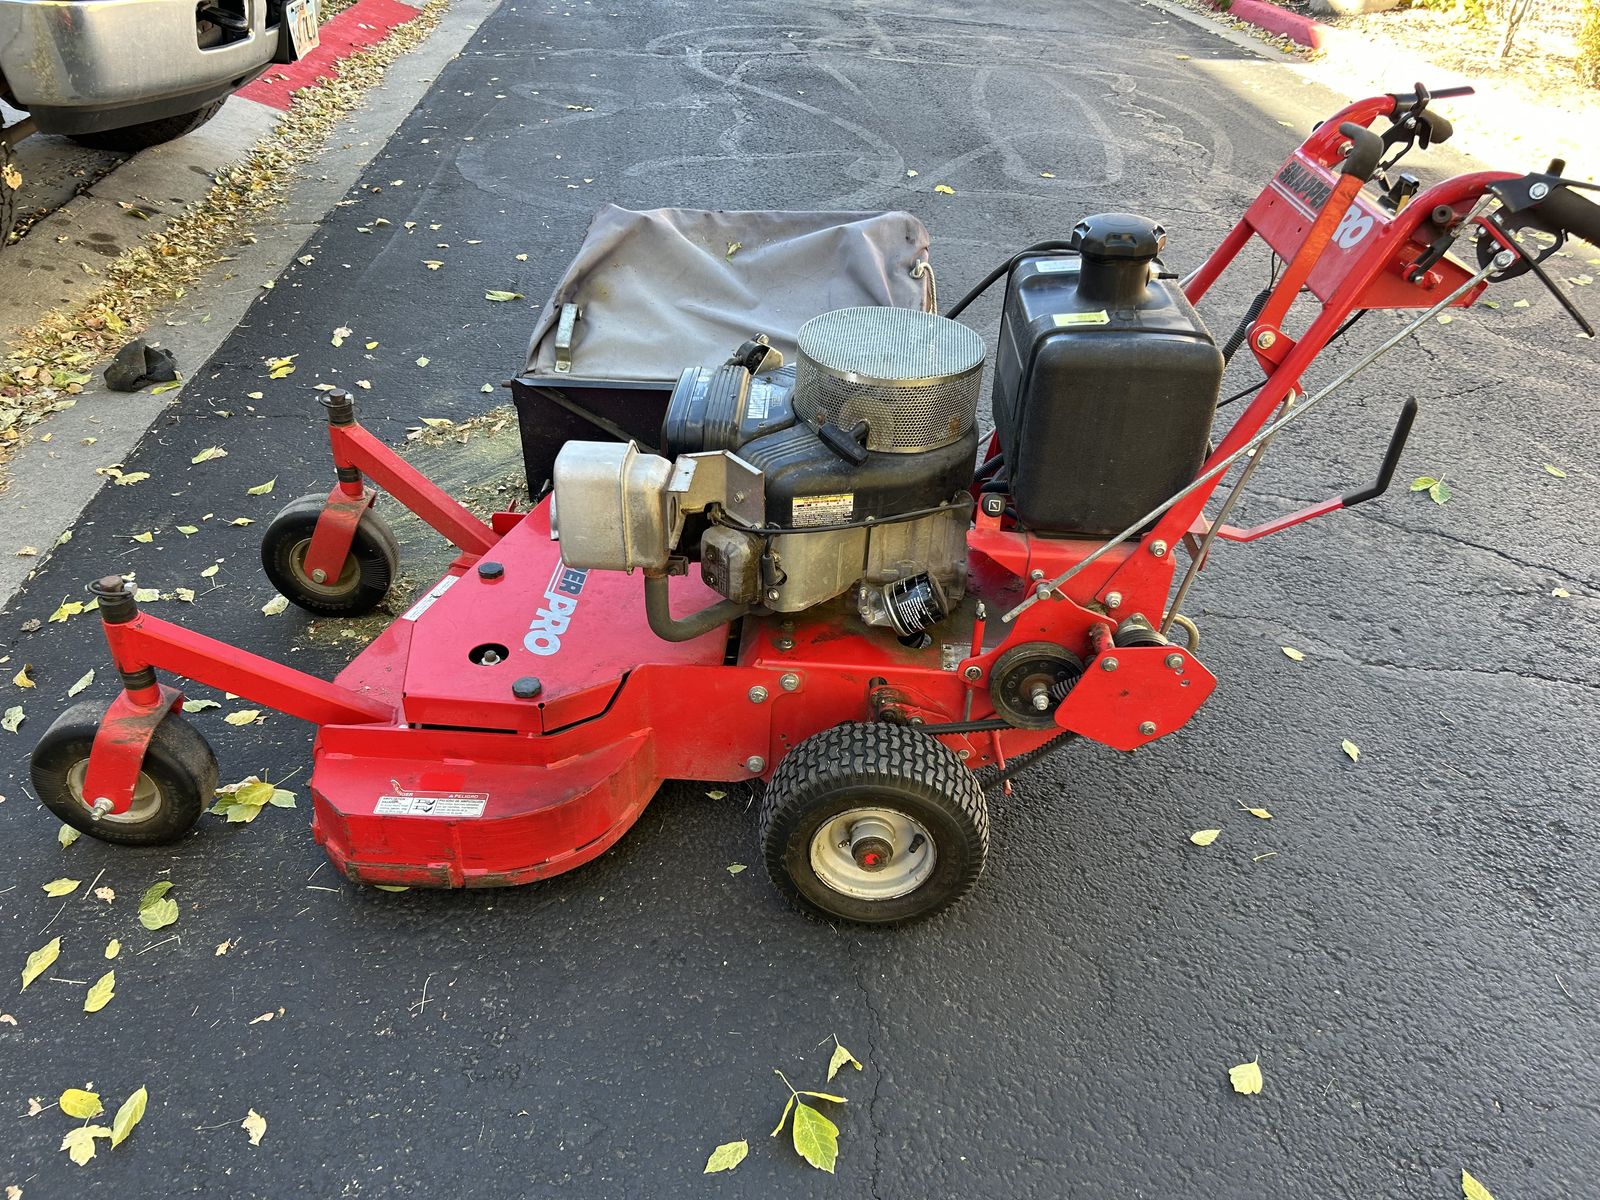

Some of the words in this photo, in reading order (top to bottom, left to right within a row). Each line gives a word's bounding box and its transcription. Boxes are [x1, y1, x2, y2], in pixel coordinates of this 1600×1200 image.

[1278, 160, 1333, 210] SNAPPE
[1331, 204, 1374, 249] RO
[558, 568, 588, 595] ER
[523, 591, 578, 656] PRO
